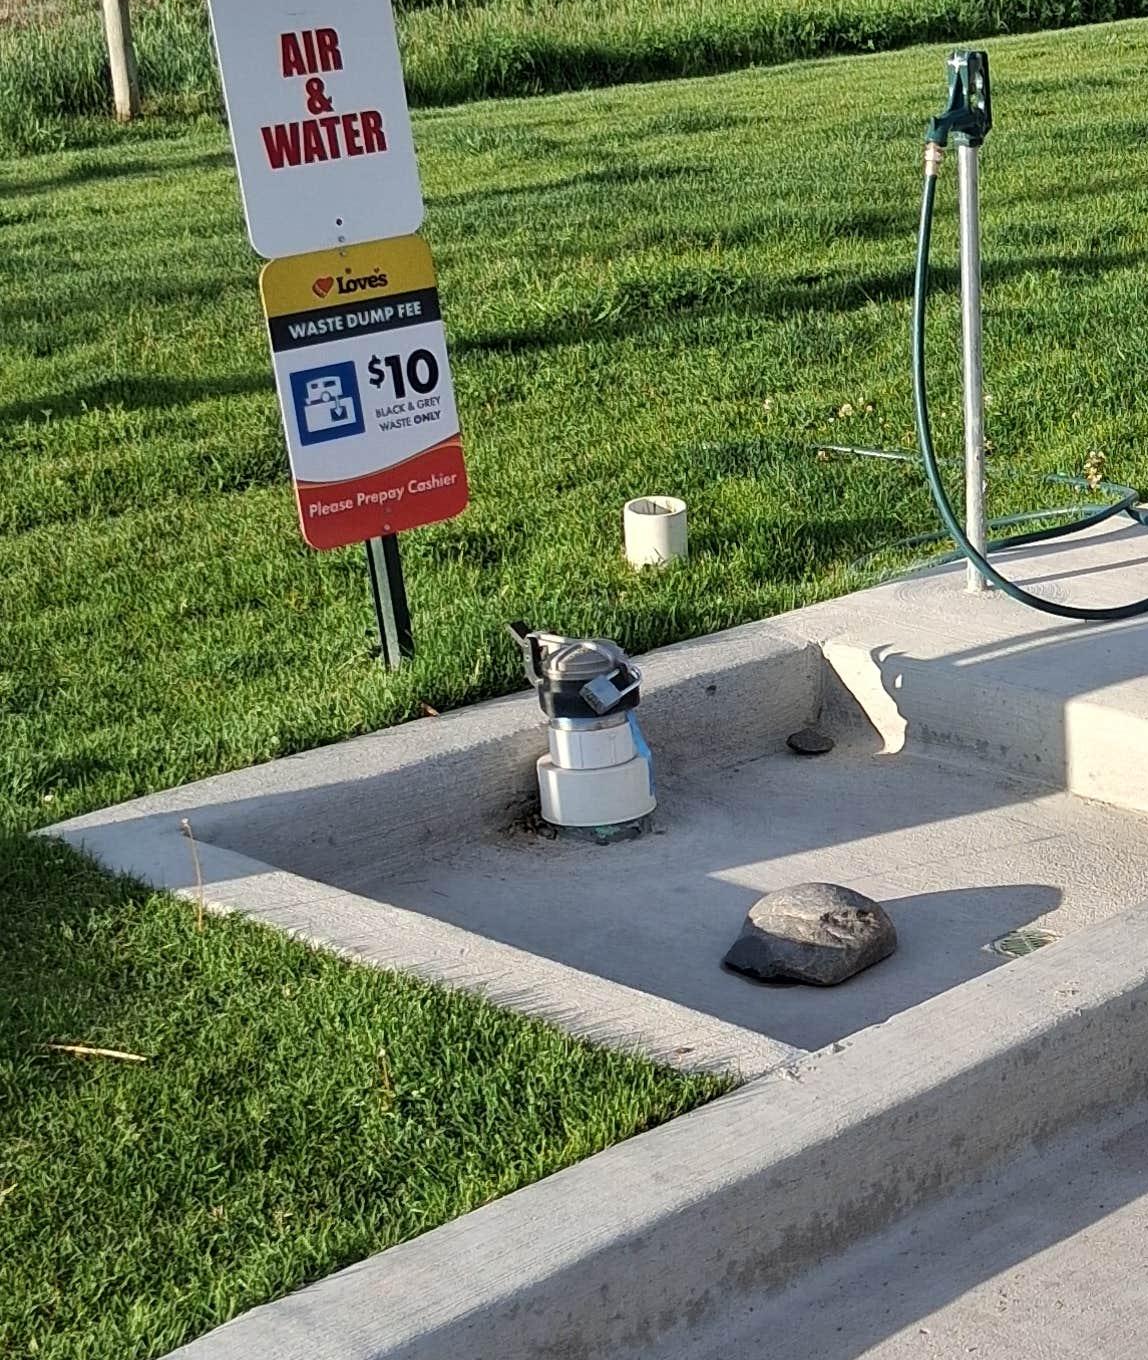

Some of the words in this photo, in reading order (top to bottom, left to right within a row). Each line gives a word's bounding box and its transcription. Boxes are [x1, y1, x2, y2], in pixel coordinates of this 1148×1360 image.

[280, 27, 343, 78] AIR
[305, 77, 334, 115] &
[260, 110, 388, 170] WATER
[288, 316, 344, 340] WASTE
[346, 306, 394, 329] DUMP
[397, 301, 422, 319] FEE
[368, 348, 439, 399] $10
[375, 403, 406, 418] BLACK
[408, 401, 415, 411] &
[416, 396, 440, 409] GREY
[379, 417, 412, 431] WASTE
[413, 410, 440, 424] ONLY
[309, 498, 354, 518] Please
[357, 486, 404, 506] Prepay
[408, 473, 457, 493] Cashier
